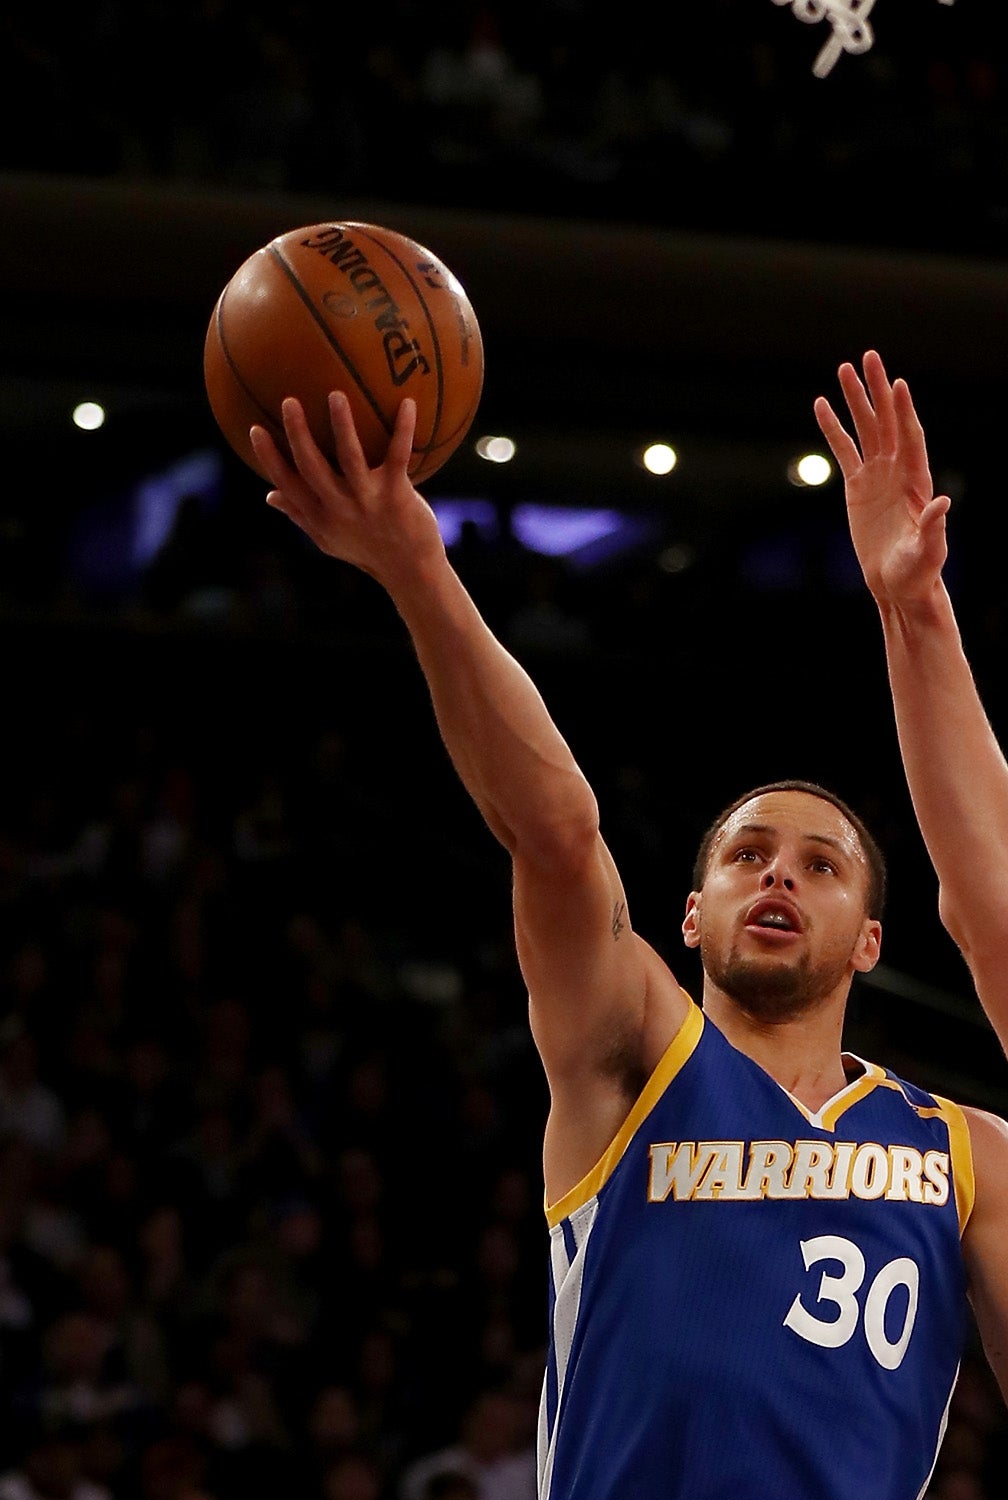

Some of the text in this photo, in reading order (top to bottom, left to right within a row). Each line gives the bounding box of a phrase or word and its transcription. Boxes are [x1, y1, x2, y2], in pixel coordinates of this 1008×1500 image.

[300, 227, 431, 388] SPALDING
[647, 1139, 950, 1207] WARRIORS
[783, 1234, 920, 1371] 30
